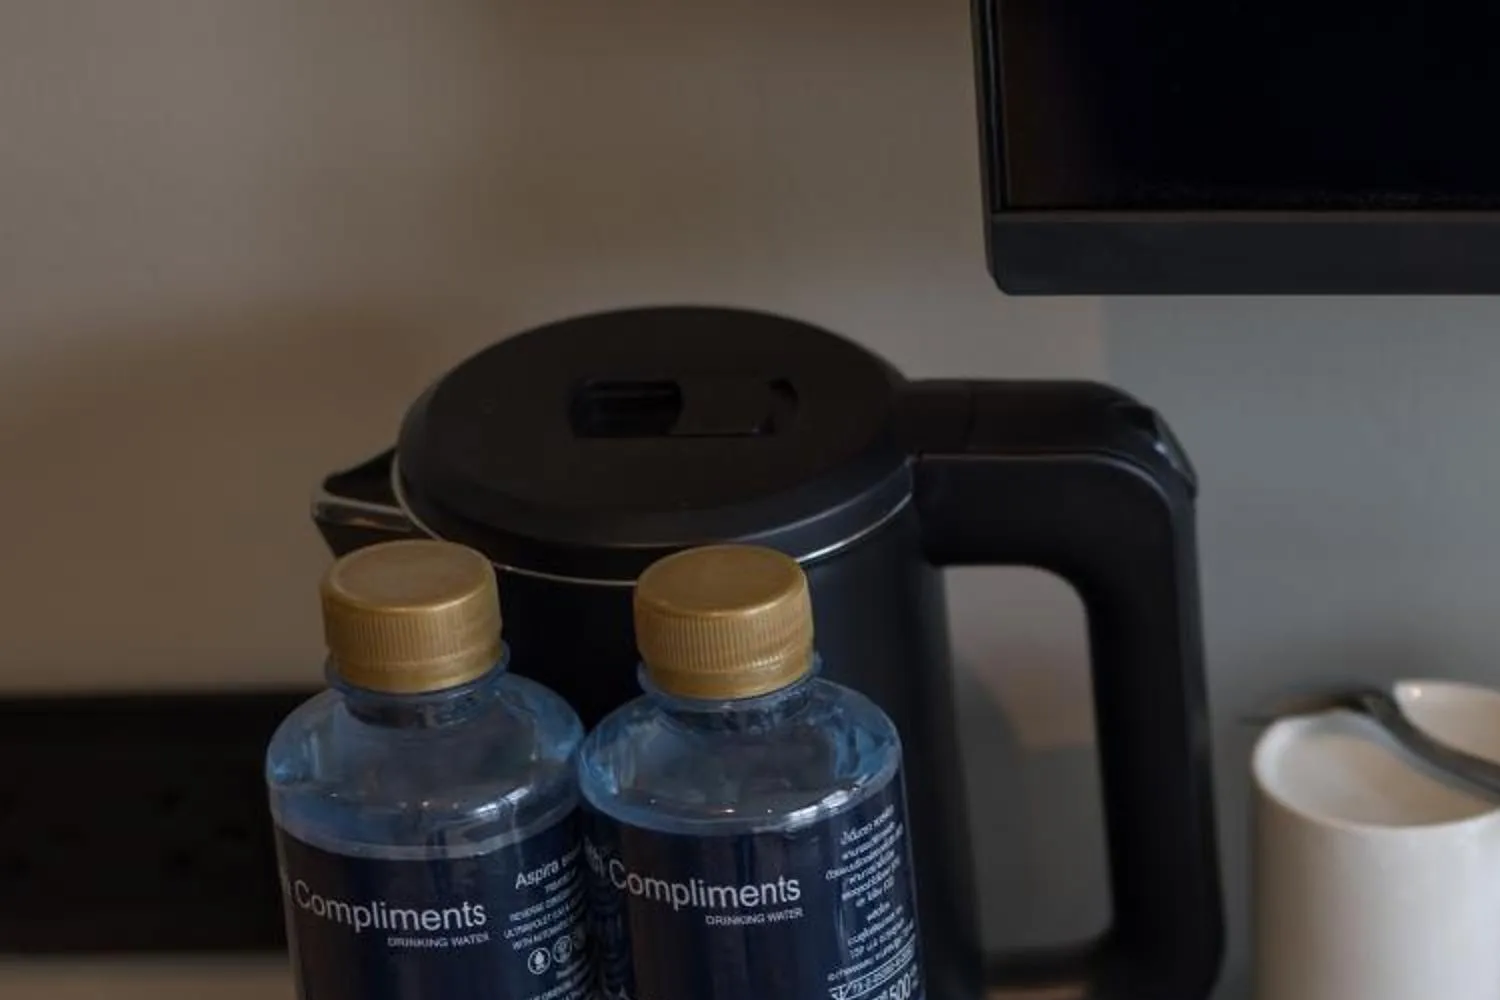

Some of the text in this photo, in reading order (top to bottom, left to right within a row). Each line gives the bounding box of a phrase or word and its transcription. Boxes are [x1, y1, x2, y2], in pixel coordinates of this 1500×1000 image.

[515, 860, 560, 890] Aspira
[608, 858, 801, 912] Compliments
[294, 878, 488, 933] Compliments
[704, 907, 804, 926] DRINKING WATER
[387, 931, 491, 949] DRINKING WATER
